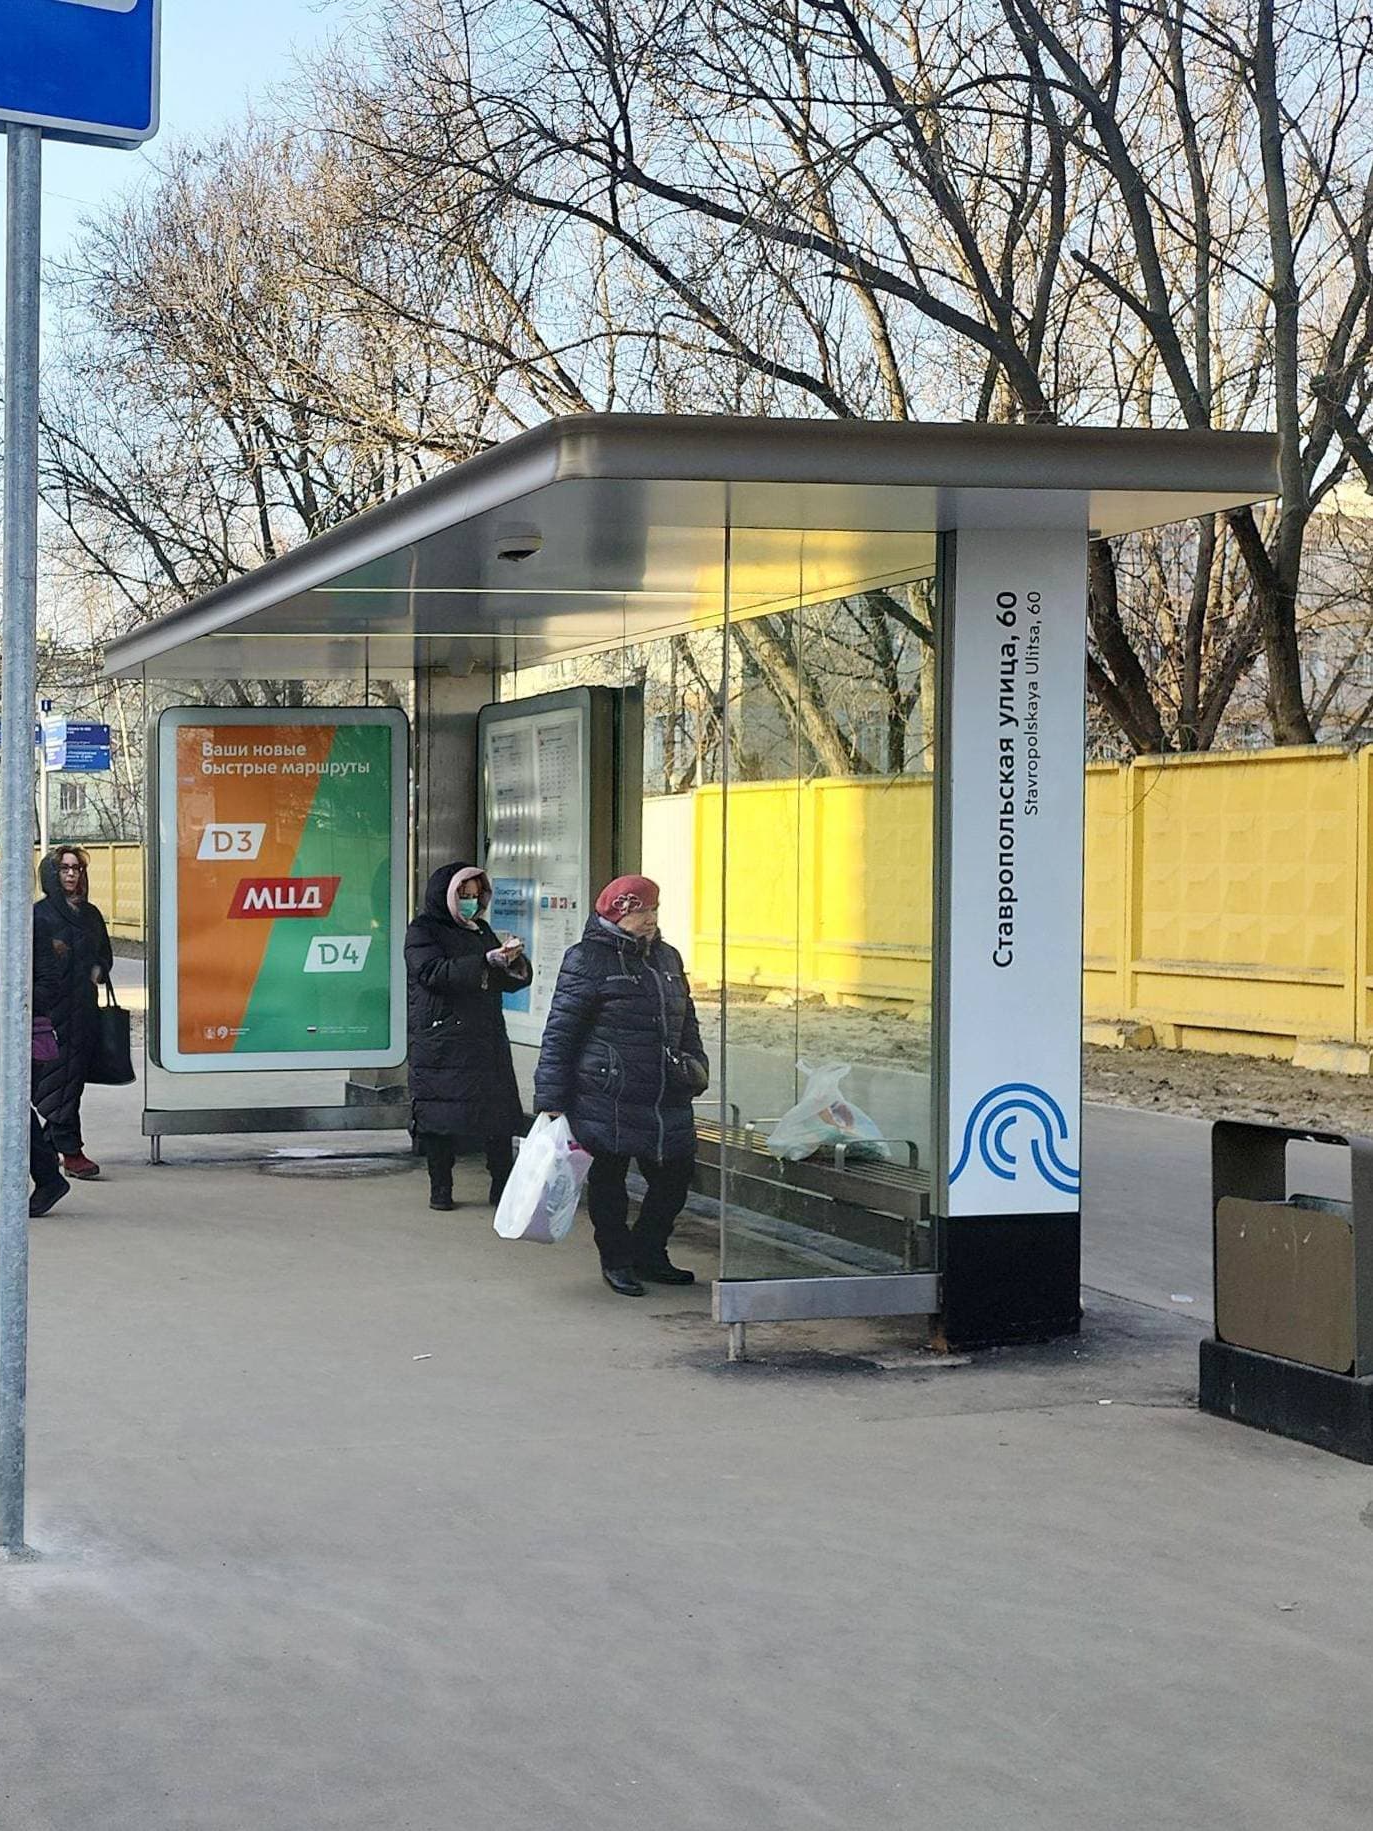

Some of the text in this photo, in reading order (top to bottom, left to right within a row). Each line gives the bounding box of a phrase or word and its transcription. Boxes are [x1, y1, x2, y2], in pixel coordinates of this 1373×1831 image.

[1023, 591, 1043, 816] Stavropolskaya Ulitsa, 60
[201, 741, 308, 758] Ваши новые
[201, 759, 371, 778] быстрые маршруты
[992, 591, 1021, 968] Ставропольская улица, 60
[211, 830, 254, 853] D3
[242, 886, 323, 910] МЦД
[318, 941, 360, 966] D4
